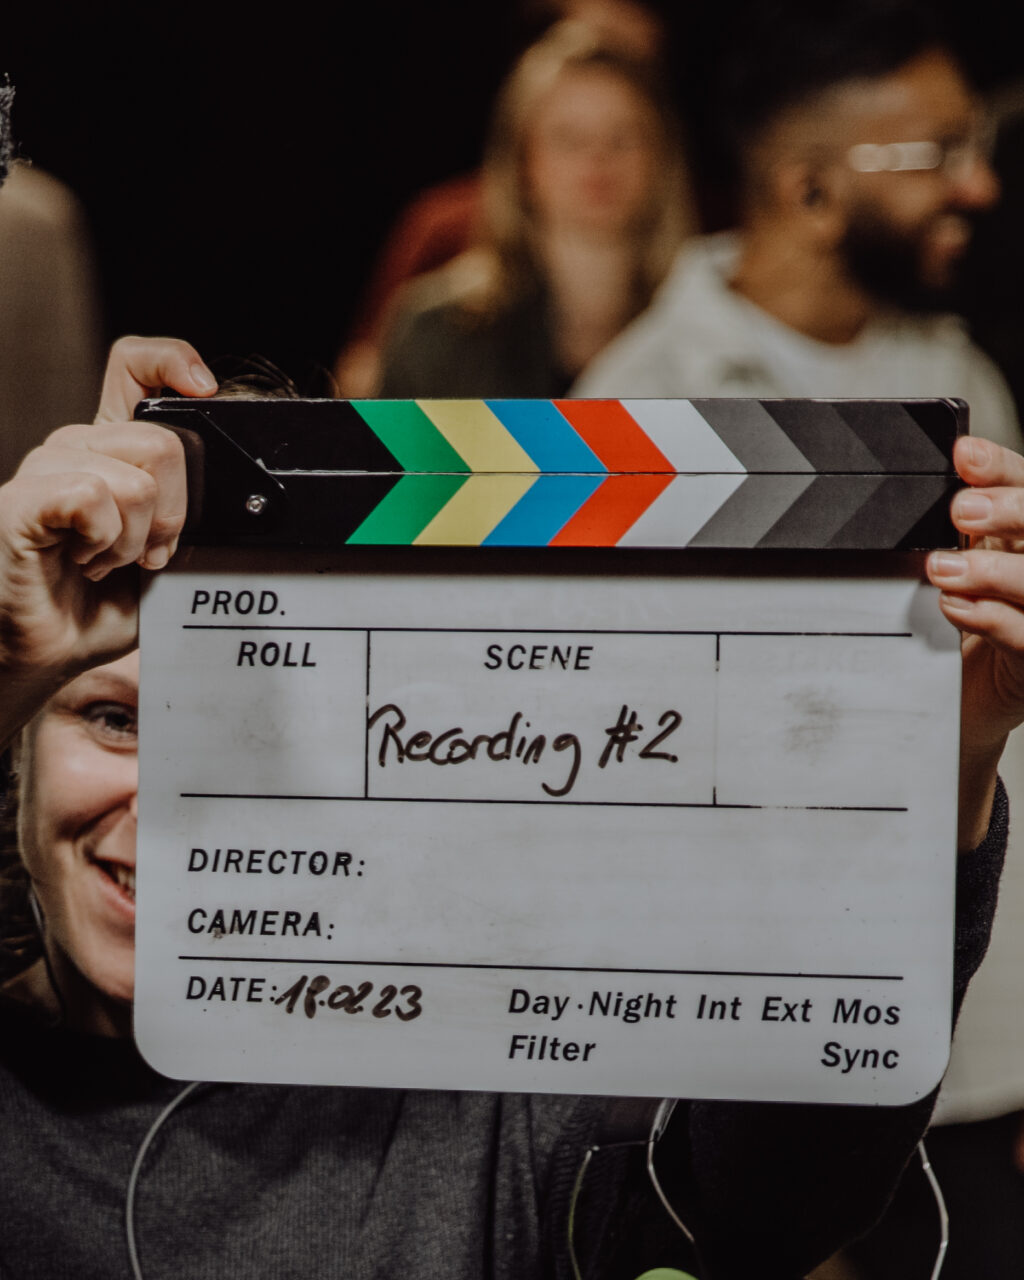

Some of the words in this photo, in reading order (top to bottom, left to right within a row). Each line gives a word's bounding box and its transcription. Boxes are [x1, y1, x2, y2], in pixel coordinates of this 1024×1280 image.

[190, 589, 285, 616] PROD.
[236, 640, 317, 668] ROLL
[483, 644, 594, 671] SCENE
[367, 704, 583, 797] Recording
[597, 704, 683, 769] #2
[187, 848, 365, 877] DIRECTOR:
[187, 907, 335, 940] CAMERA:
[185, 975, 275, 1003] DATE:
[696, 994, 742, 1021] Int
[761, 996, 813, 1023] Ext
[832, 998, 901, 1026] Mos
[508, 1034, 597, 1062] Filter
[820, 1041, 900, 1074] Sync
